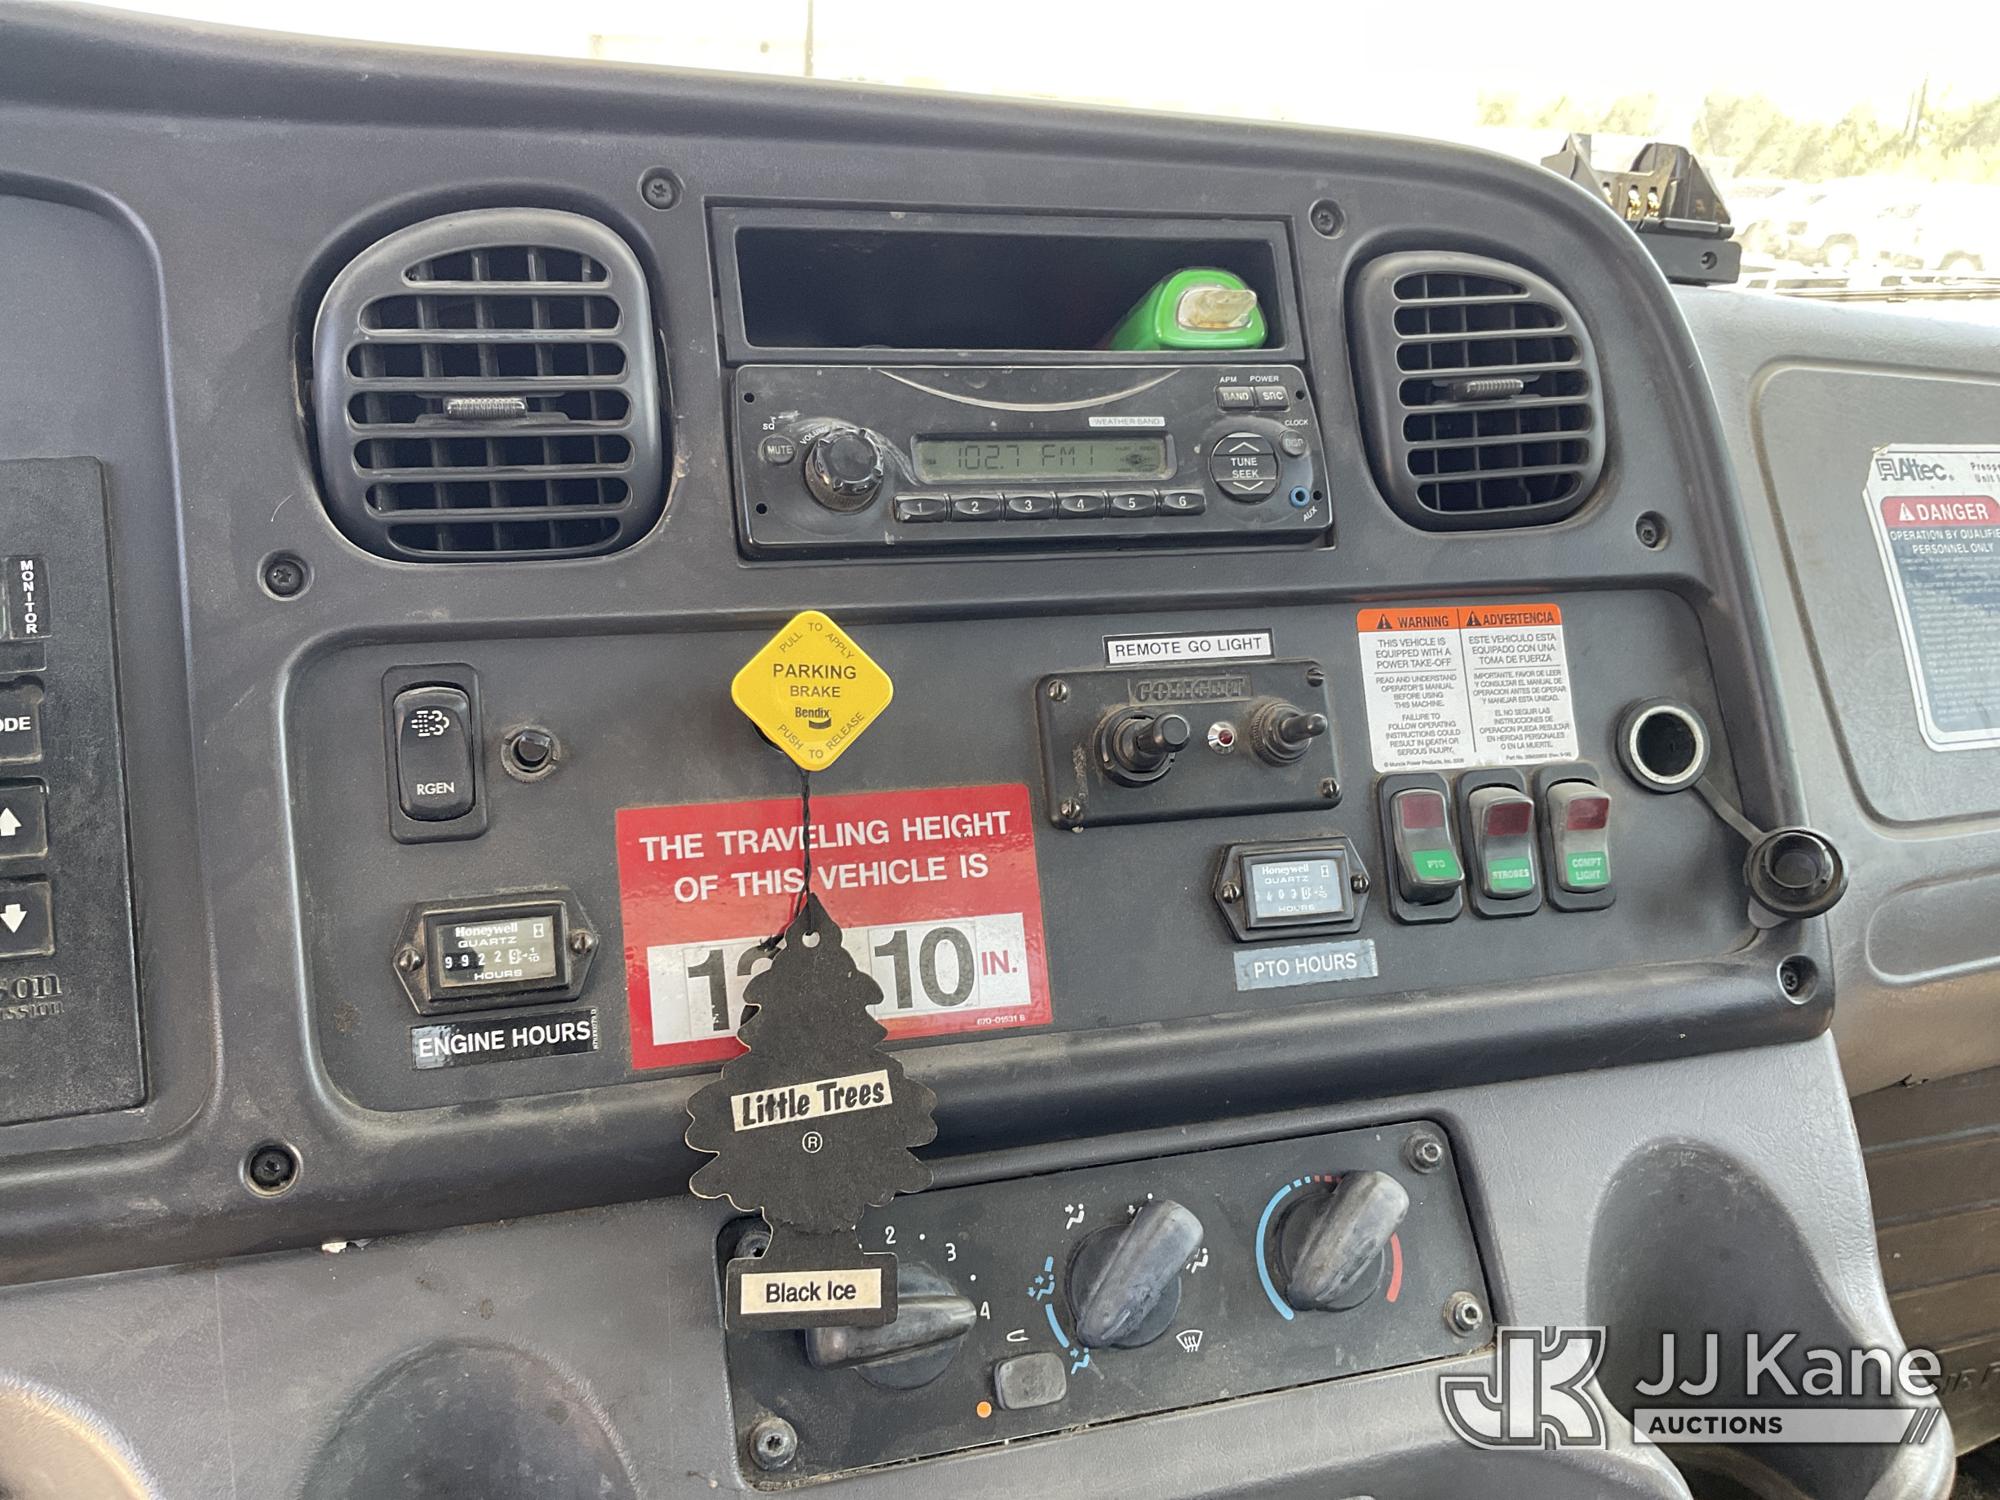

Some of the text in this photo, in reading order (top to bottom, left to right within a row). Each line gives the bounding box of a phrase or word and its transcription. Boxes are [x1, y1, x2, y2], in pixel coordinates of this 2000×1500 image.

[1262, 392, 1284, 401] SRC
[767, 445, 794, 455] MUTE
[1230, 457, 1258, 467] TUNE
[1232, 470, 1260, 480] SEEK
[916, 502, 923, 512] 1
[971, 501, 980, 512] 2
[1024, 500, 1033, 511] 3
[1076, 499, 1085, 510] 4
[1128, 498, 1136, 508] 5
[1178, 496, 1187, 506] 6
[1303, 506, 1318, 522] AUX
[1916, 503, 1989, 521] DANGER
[1890, 530, 1944, 541] OPERATION
[1945, 530, 1958, 540] BY
[1912, 542, 1994, 554] PERSONNEL ONLY
[20, 560, 38, 634] MONITOR
[1398, 615, 1449, 628] WARNING
[1483, 611, 1554, 626] ADVERTENCIA
[779, 622, 855, 660] PULL TO APPLY
[1378, 637, 1446, 649] THIS VEHICLE IS
[1469, 633, 1557, 645] ESTE VEHICULO ESTA
[1115, 637, 1262, 657] REMOTE GO LIGHT
[1472, 643, 1556, 655] EQUIPADO CON UNA
[1376, 648, 1452, 659] EQUIPPED WITH A
[1480, 654, 1552, 665] TOMA DE FUERZA
[1376, 658, 1451, 669] POWER TAKE-OFF
[773, 663, 858, 680] PARKING
[1376, 674, 1456, 684] READ AND UNDERSTAND
[790, 686, 842, 698] BRAKE
[1394, 692, 1444, 700] BEFORE USING
[1394, 701, 1410, 709] THIS
[795, 706, 831, 719] Bendix
[1402, 712, 1441, 721] FAILURE TO
[1388, 720, 1457, 731] FOLLOW OPERATING
[778, 712, 866, 759] PUSH TO RELEASE
[1385, 729, 1461, 740] INSTRUCTIONS COULD
[1397, 748, 1428, 756] SERIOUS
[416, 782, 455, 796] RGEN
[638, 810, 1012, 862] THE TRAVELING HEIGHT
[1262, 864, 1310, 876] Honeywell
[1427, 860, 1446, 870] PTO
[673, 853, 989, 903] OF THIS VEHICLE IS
[1491, 868, 1530, 880] STROBES
[1575, 869, 1601, 880] LIGHT
[1264, 876, 1309, 885] QUARTZ
[1278, 904, 1316, 912] HOURS
[455, 922, 518, 938] Honeywell
[458, 936, 518, 949] QUARTZ
[873, 926, 975, 1010] 10
[980, 949, 1019, 977] IN.
[1254, 959, 1290, 978] PTO
[1296, 952, 1358, 974] HOURS
[474, 968, 523, 981] HOURS
[419, 1029, 506, 1058] ENGINE
[512, 1020, 591, 1049] HOURS
[742, 1080, 886, 1128] Little Trees
[884, 1225, 897, 1244] 2
[945, 1242, 957, 1262] 3
[766, 1280, 857, 1304] Black Ice
[980, 1300, 991, 1320] 4
